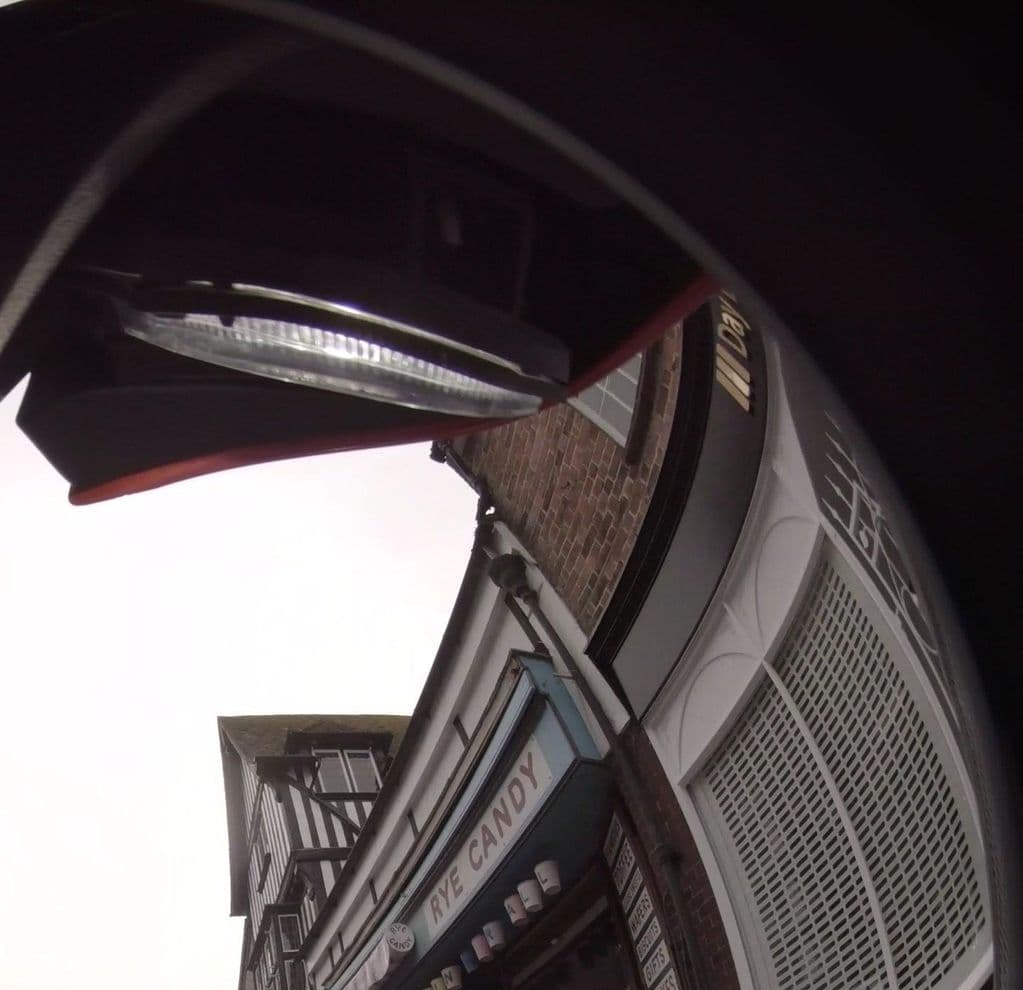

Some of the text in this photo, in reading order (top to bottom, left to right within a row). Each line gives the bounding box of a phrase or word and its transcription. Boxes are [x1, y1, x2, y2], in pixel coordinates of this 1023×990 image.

[429, 866, 464, 925] RYE
[467, 751, 538, 871] CANDY
[389, 937, 412, 950] CANDY
[645, 946, 666, 979] GIFTS
